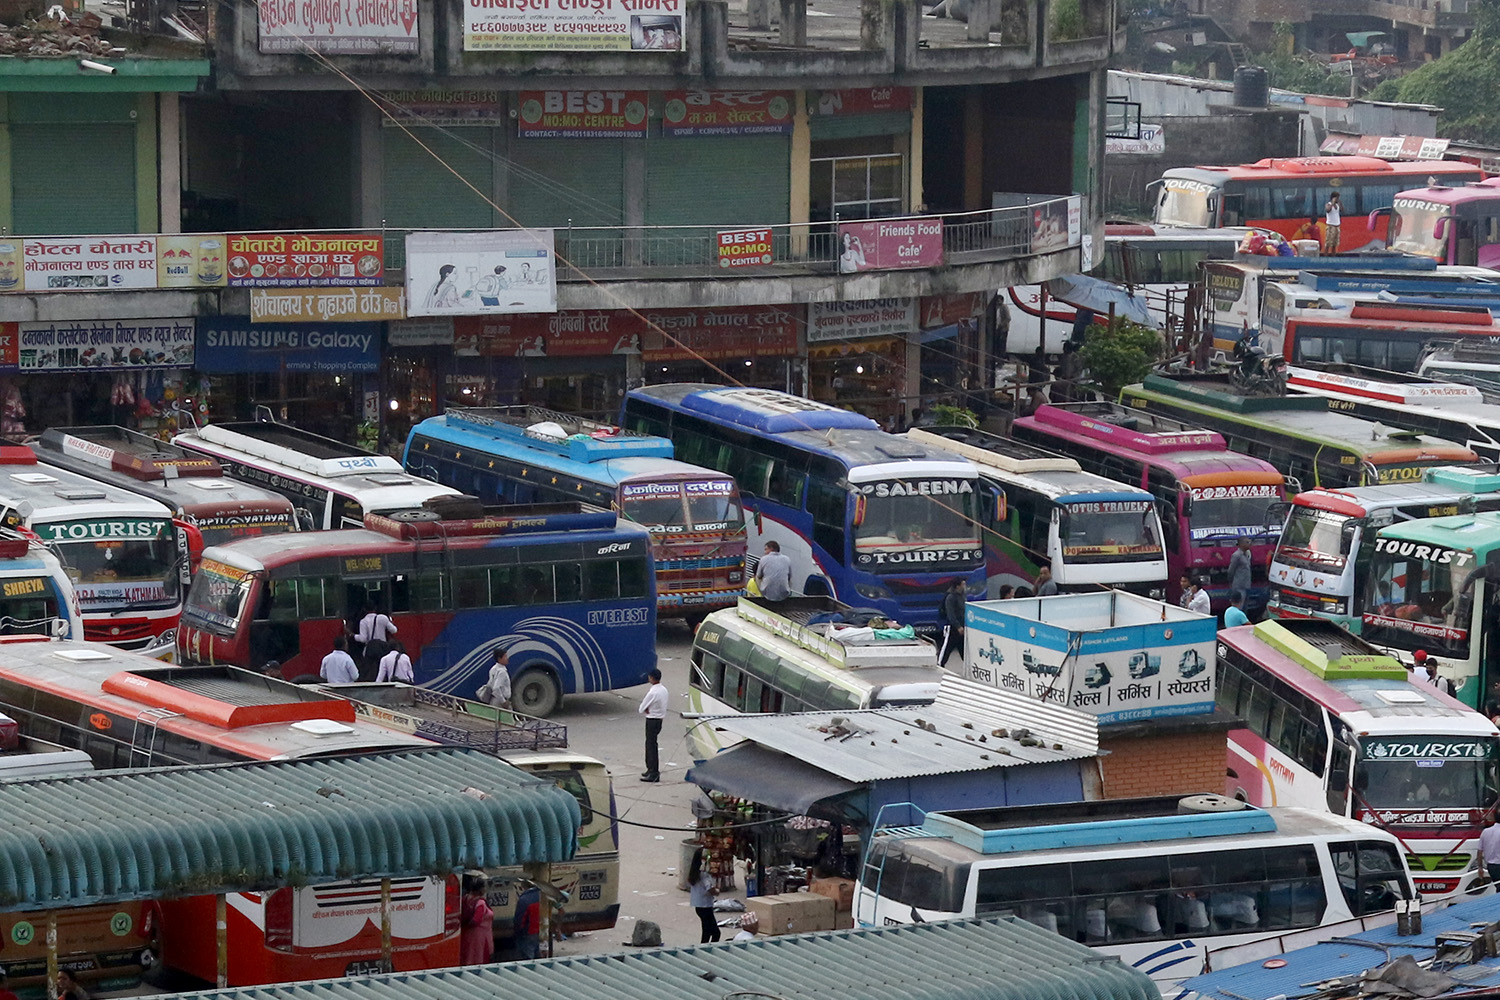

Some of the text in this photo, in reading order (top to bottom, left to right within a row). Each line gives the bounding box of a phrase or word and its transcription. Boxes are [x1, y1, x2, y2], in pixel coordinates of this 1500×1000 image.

[544, 91, 625, 114] BEST
[584, 115, 626, 128] CENTRE
[1164, 179, 1217, 194] TOURIST
[1394, 199, 1450, 213] TOURIST
[722, 231, 767, 244] BEST
[880, 223, 941, 237] Friends Food
[25, 240, 154, 256] होटल चौतारी
[231, 236, 379, 252] चौतारी भोजनालय
[25, 259, 82, 272] भोजनालय
[258, 254, 353, 264] एण्ड खाजा घर
[731, 257, 760, 266] CENTER
[306, 295, 314, 315] र
[207, 330, 372, 353] SAMSUNG Galaxy
[347, 361, 377, 371] Complex
[876, 480, 973, 497] SALEENA
[1191, 486, 1277, 500] GODAWARI
[1067, 501, 1148, 513] LOTUS TRAVELS
[244, 514, 289, 523] YATAYAT
[49, 521, 166, 539] TOURIST
[873, 550, 973, 563] TOURIST
[1375, 538, 1473, 567] TOURIST
[4, 578, 45, 596] SHREYA
[588, 608, 649, 625] EVEREST
[1073, 691, 1101, 707] सेल्स
[1387, 742, 1476, 757] TOURIST
